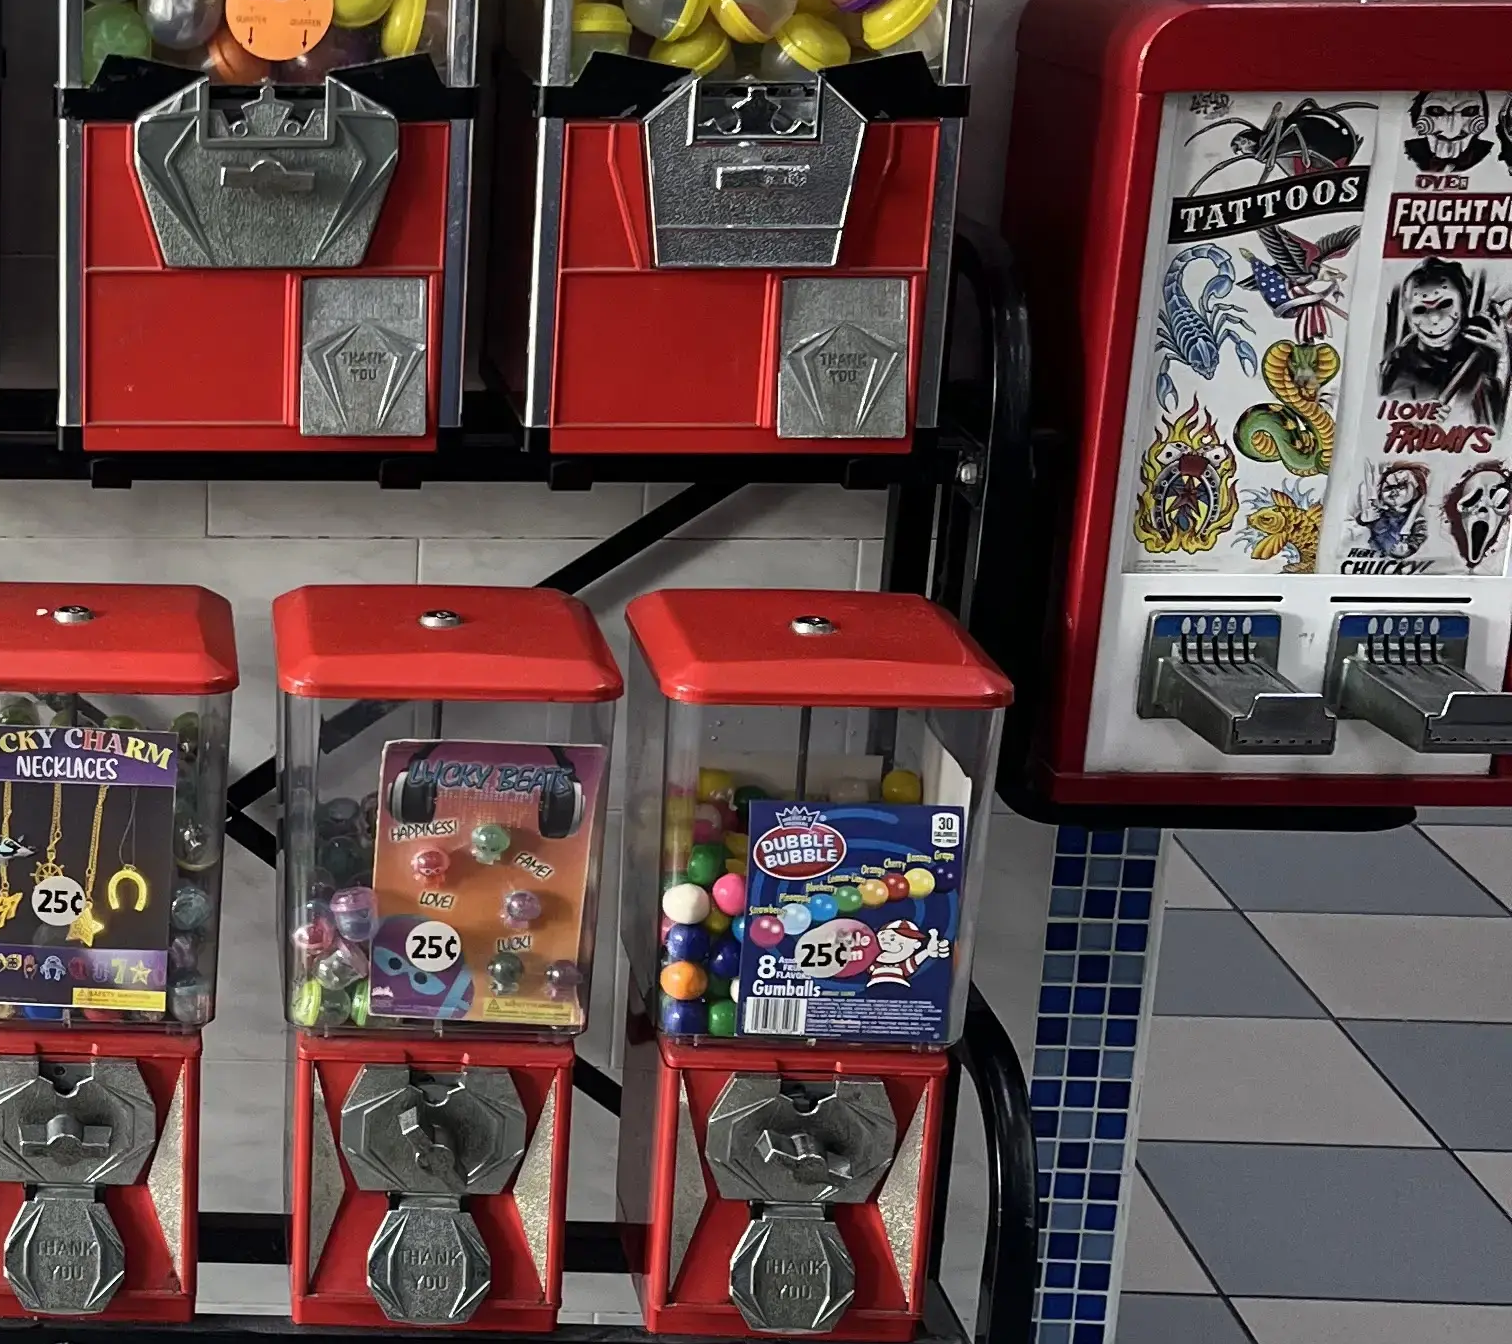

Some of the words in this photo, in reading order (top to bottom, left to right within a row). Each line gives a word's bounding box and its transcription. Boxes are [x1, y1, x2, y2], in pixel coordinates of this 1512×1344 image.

[1180, 176, 1360, 233] TATTOOS
[1393, 198, 1489, 237] FRIGHT
[1398, 225, 1512, 251] TATTO
[350, 368, 377, 382] YOU
[829, 369, 857, 387] YOU
[1377, 400, 1387, 420] I
[1388, 400, 1443, 421] LOVE
[1383, 421, 1496, 454] FRIDAYS
[1340, 559, 1435, 575] CHUCKY!
[64, 727, 174, 770] CHARM
[16, 755, 118, 780] NECKLACES
[408, 760, 494, 791] LUCKY
[496, 765, 574, 796] BEATS
[391, 820, 457, 841] HAPPINESS!
[938, 817, 954, 830] 30
[761, 834, 835, 854] DUBBLE
[515, 852, 553, 878] FAME!
[764, 848, 838, 869] BUBBLE
[884, 857, 907, 872] Cherry
[37, 889, 83, 916] 25¢
[419, 891, 455, 909] LOVE!
[411, 935, 457, 960] 25¢
[497, 936, 531, 951] LUCK!
[801, 942, 847, 967] 25¢
[757, 955, 776, 979] 8
[752, 979, 821, 997] Gumballs
[35, 1240, 98, 1256] THANK
[399, 1248, 463, 1266] THANK
[49, 1265, 84, 1281] YOU
[762, 1259, 827, 1276] THANK
[412, 1275, 449, 1291] YOU
[776, 1284, 813, 1300] YOU
